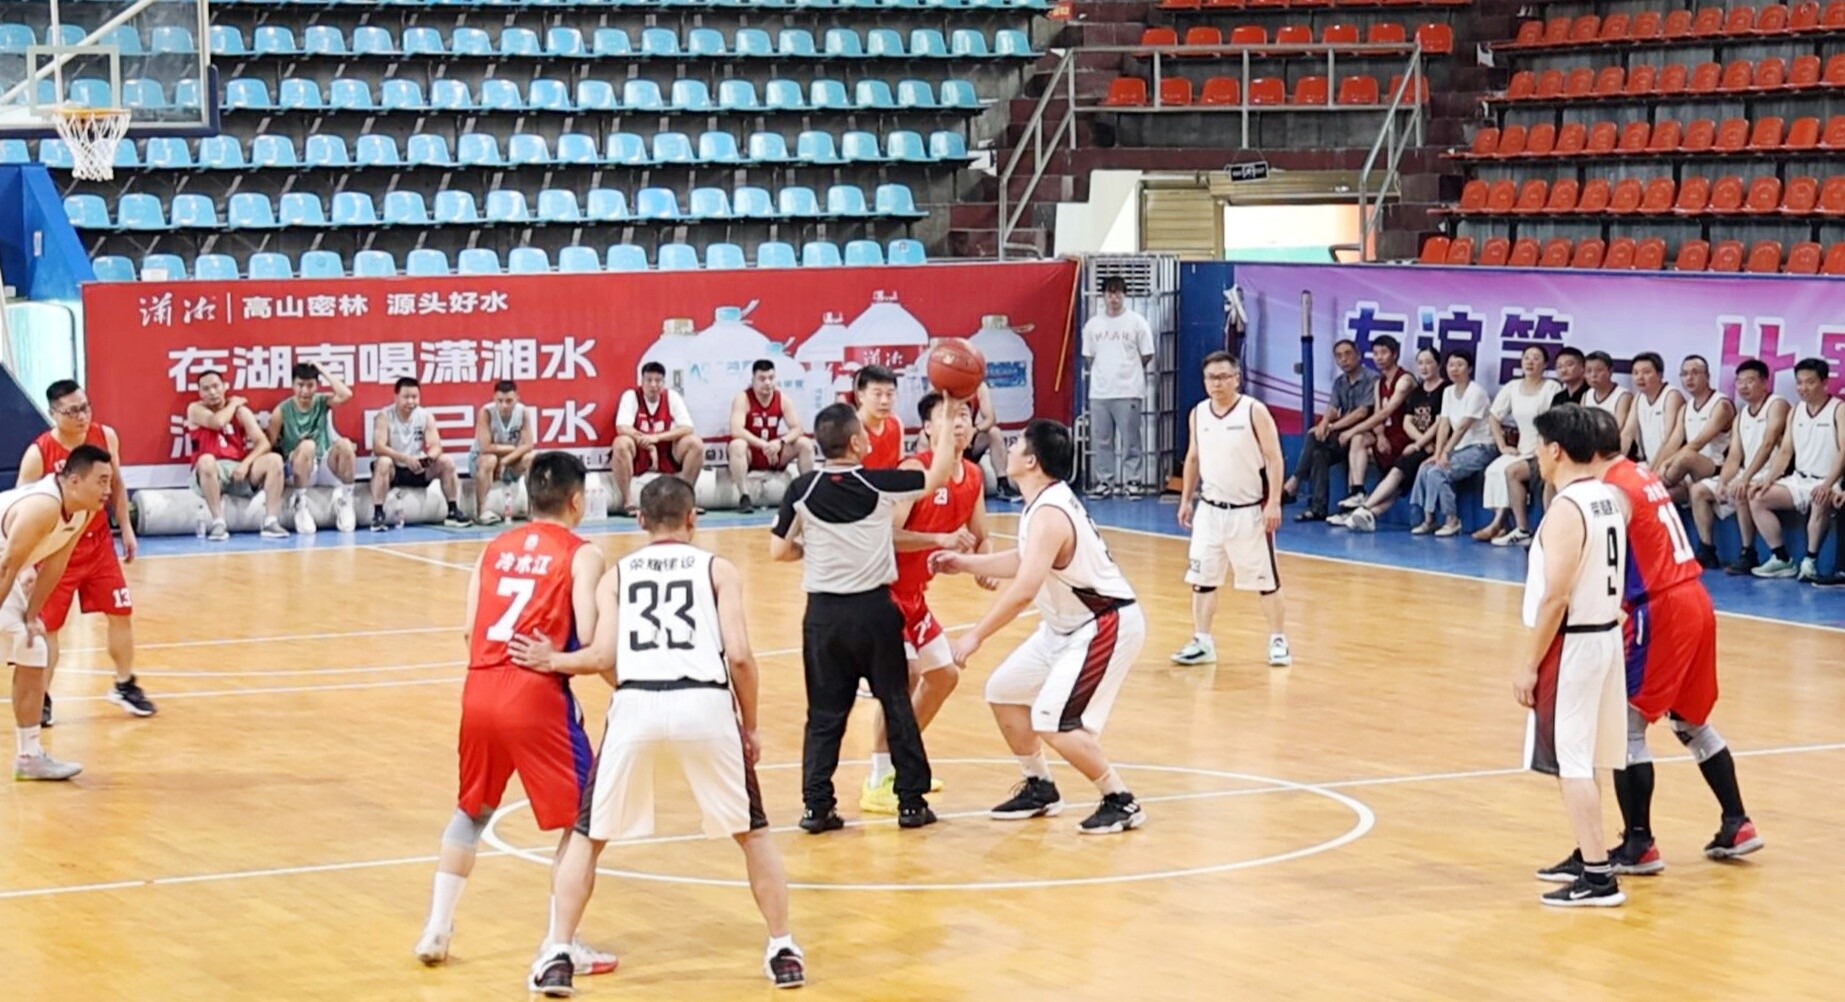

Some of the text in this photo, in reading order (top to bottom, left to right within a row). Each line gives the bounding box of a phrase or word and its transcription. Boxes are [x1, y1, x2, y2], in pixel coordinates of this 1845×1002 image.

[242, 294, 368, 319] 高山密林
[387, 291, 508, 316] 源头好水
[167, 336, 597, 392] 在湖南喝潇湘水
[1607, 526, 1619, 596] 9
[112, 588, 133, 608] 13
[486, 576, 537, 642] 7
[628, 579, 696, 652] 33
